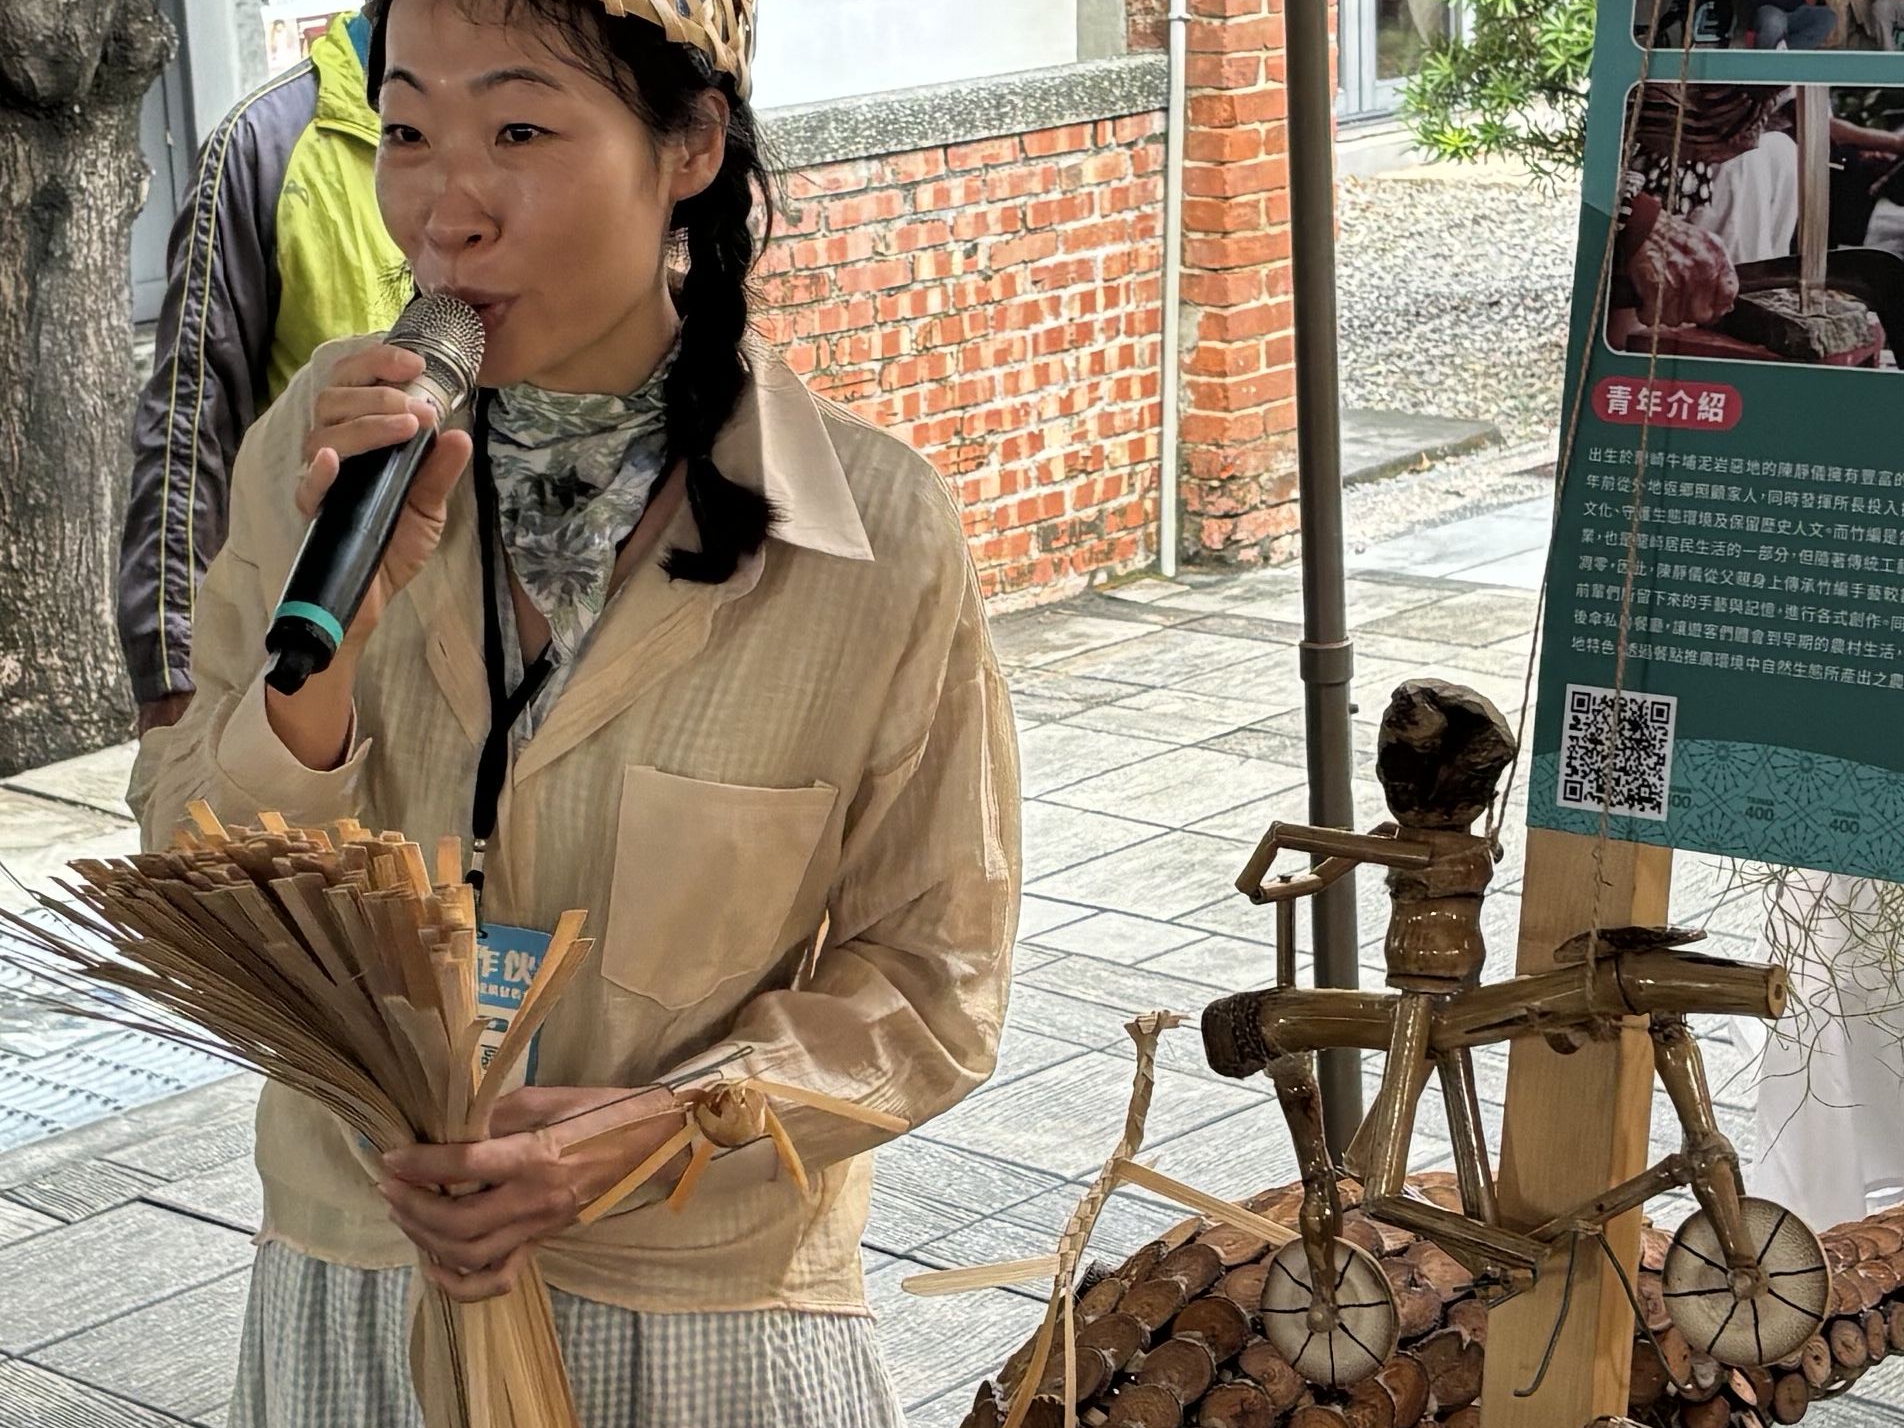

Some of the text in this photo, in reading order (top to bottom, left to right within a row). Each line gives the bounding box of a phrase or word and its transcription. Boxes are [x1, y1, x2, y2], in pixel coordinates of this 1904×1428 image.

[1605, 384, 1727, 424] 青年介紹
[1667, 794, 1692, 809] 00
[1746, 806, 1774, 822] 400
[1828, 818, 1860, 835] 400
